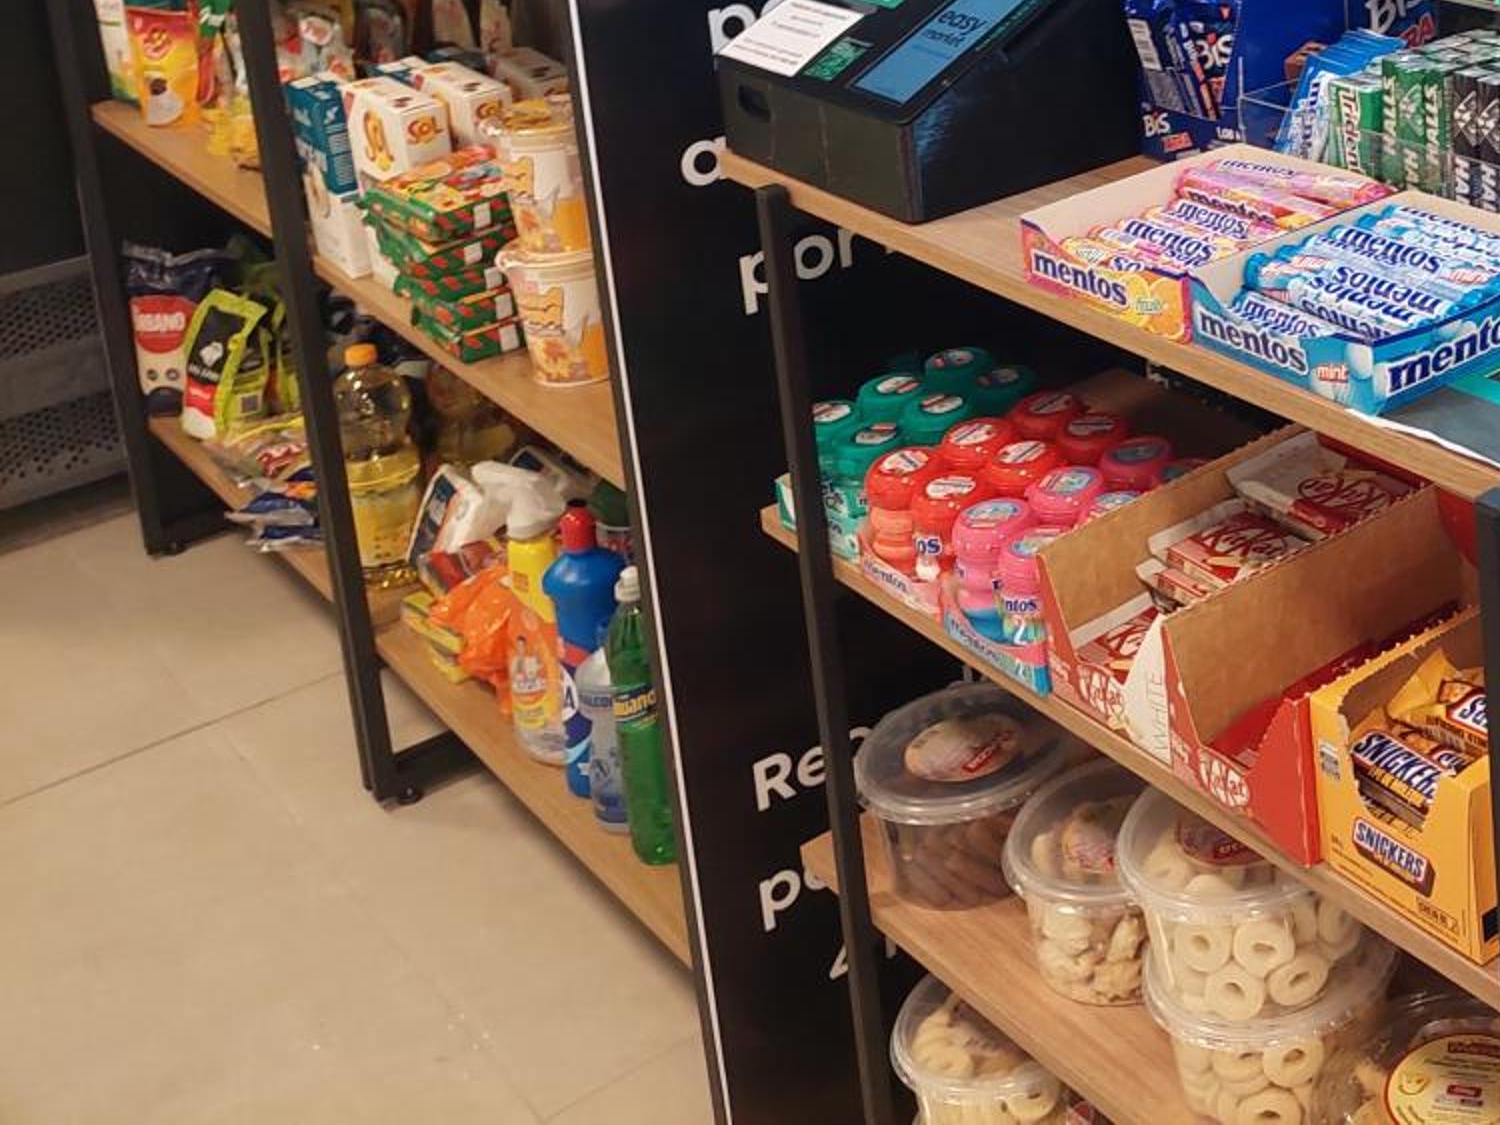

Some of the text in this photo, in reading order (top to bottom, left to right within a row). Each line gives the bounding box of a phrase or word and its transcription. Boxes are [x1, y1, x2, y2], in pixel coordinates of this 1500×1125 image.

[937, 6, 990, 34] easy
[1144, 107, 1171, 137] BiS
[1123, 219, 1216, 263] mentos
[1174, 199, 1250, 240] mentos
[1340, 227, 1443, 274] mentos
[1033, 251, 1128, 307] mentos
[1334, 264, 1444, 316] mentos
[1242, 297, 1322, 339] mentos
[1199, 310, 1308, 375] mentos
[1316, 363, 1349, 382] mint
[1355, 821, 1424, 880] SNICKERS
